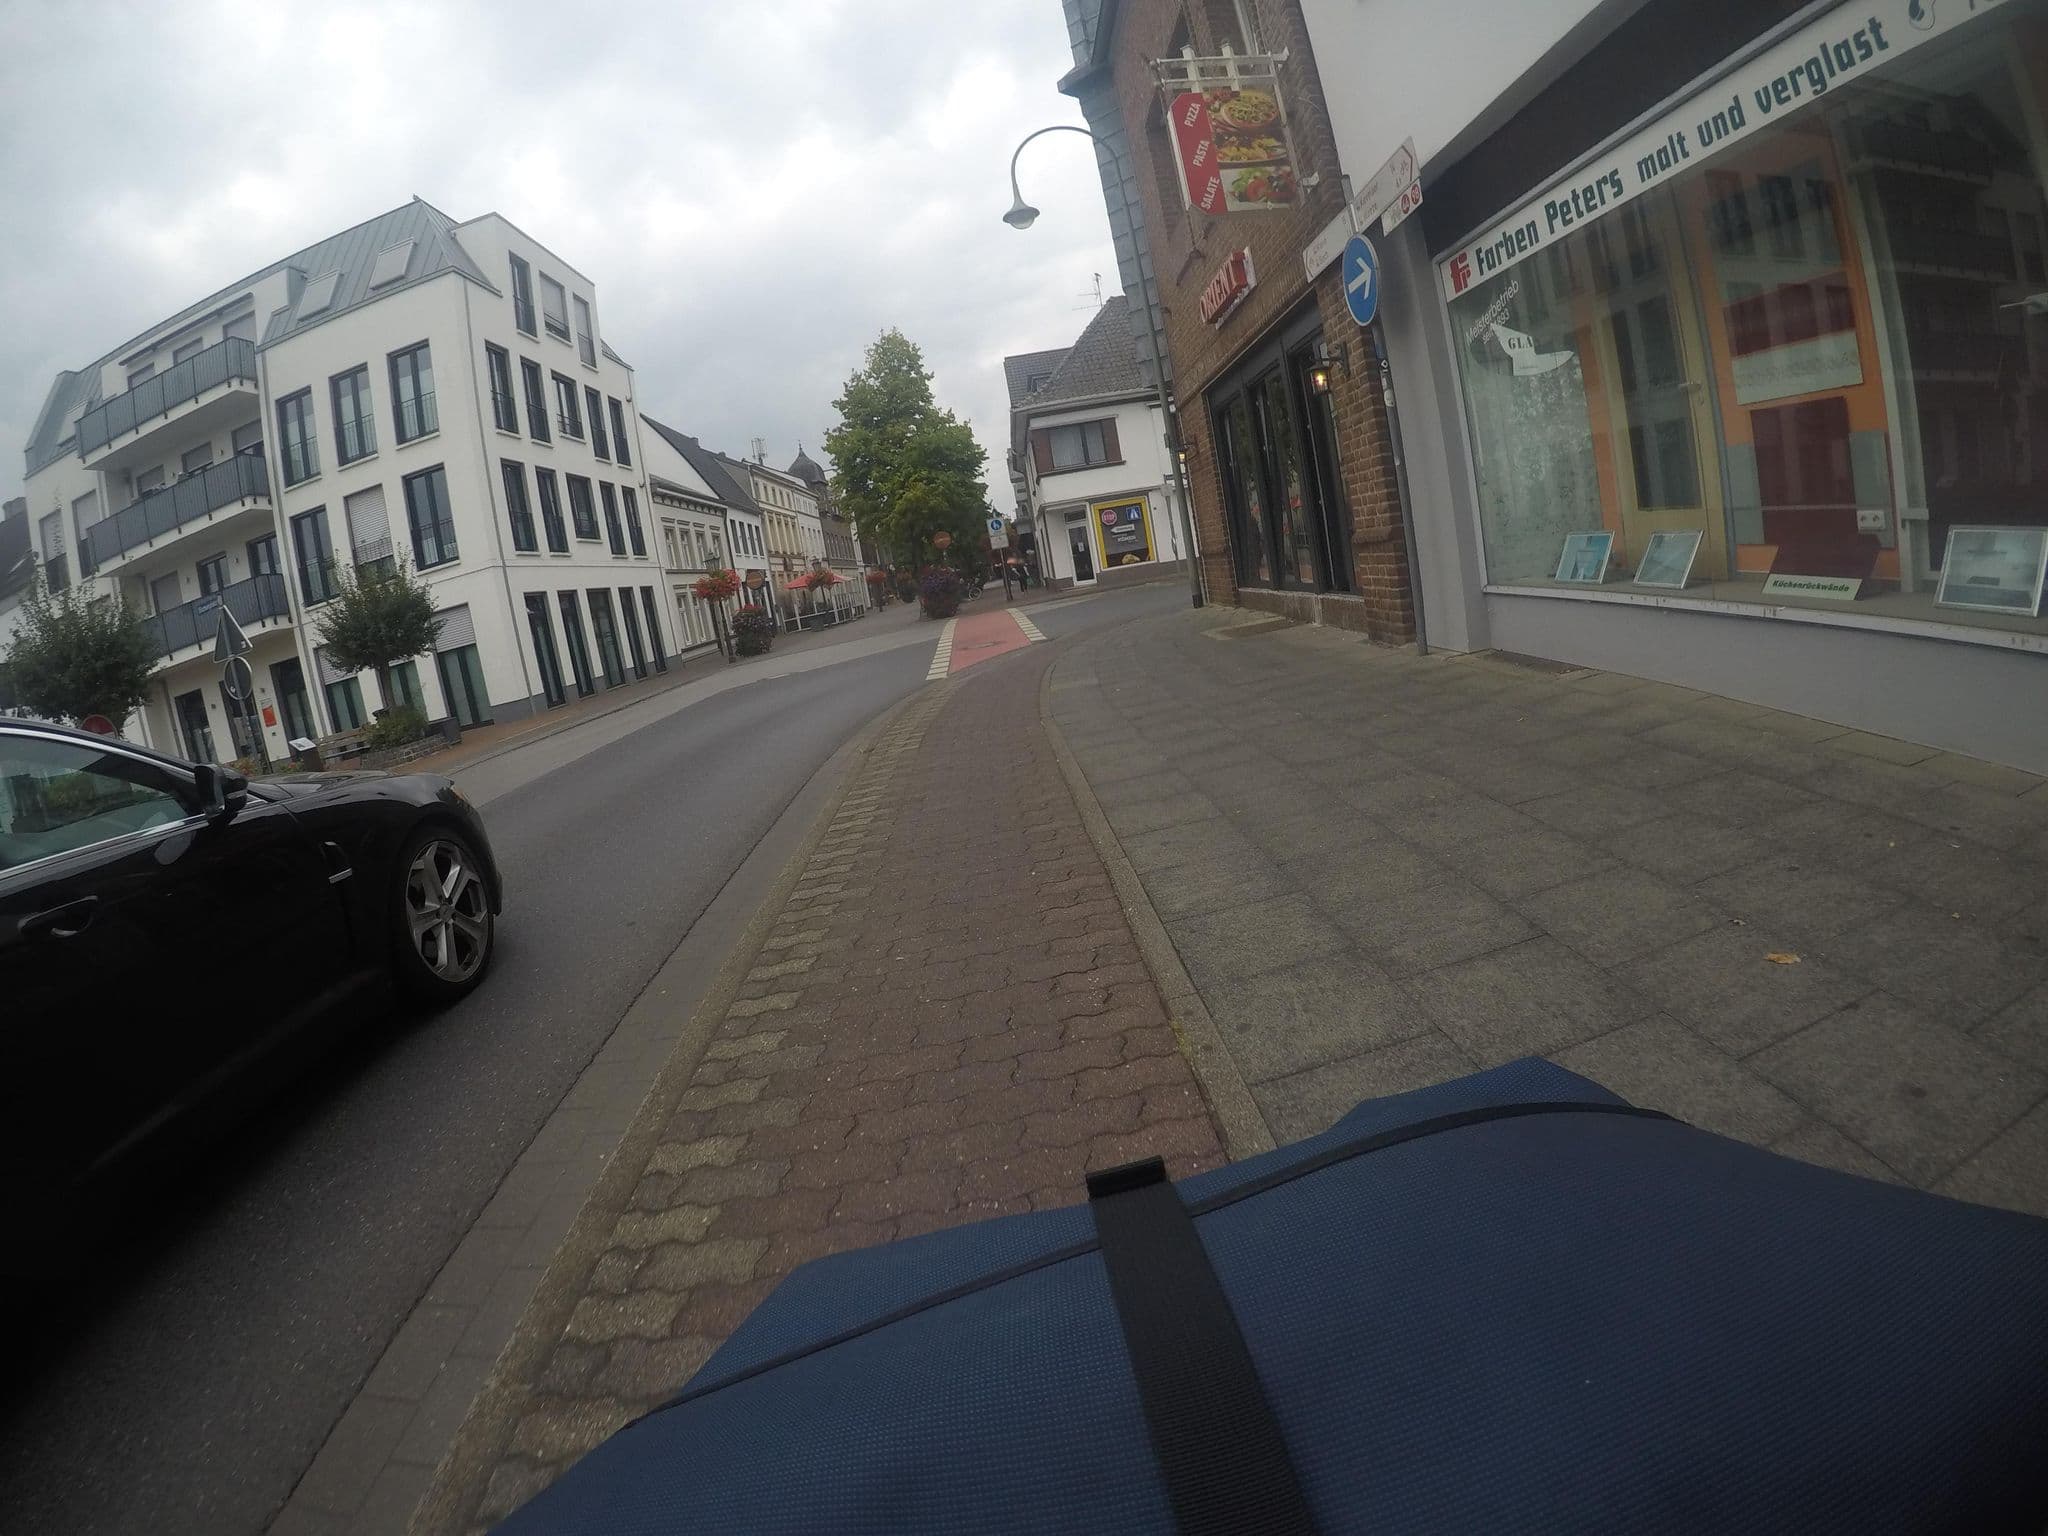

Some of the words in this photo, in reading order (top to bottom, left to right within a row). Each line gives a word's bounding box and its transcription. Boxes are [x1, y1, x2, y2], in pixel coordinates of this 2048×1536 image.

[1184, 102, 1201, 127] PIZZA
[1193, 140, 1210, 167] PASTA
[1475, 219, 1540, 277] Farben
[1544, 166, 1625, 236] Peters
[1636, 130, 1691, 184] malt
[1696, 94, 1747, 149] und
[1753, 15, 1889, 115] verglast
[1201, 176, 1220, 209] SALATE
[1465, 280, 1520, 346] Meisterbetrieb
[1772, 580, 1850, 592] Küchenrückwände
